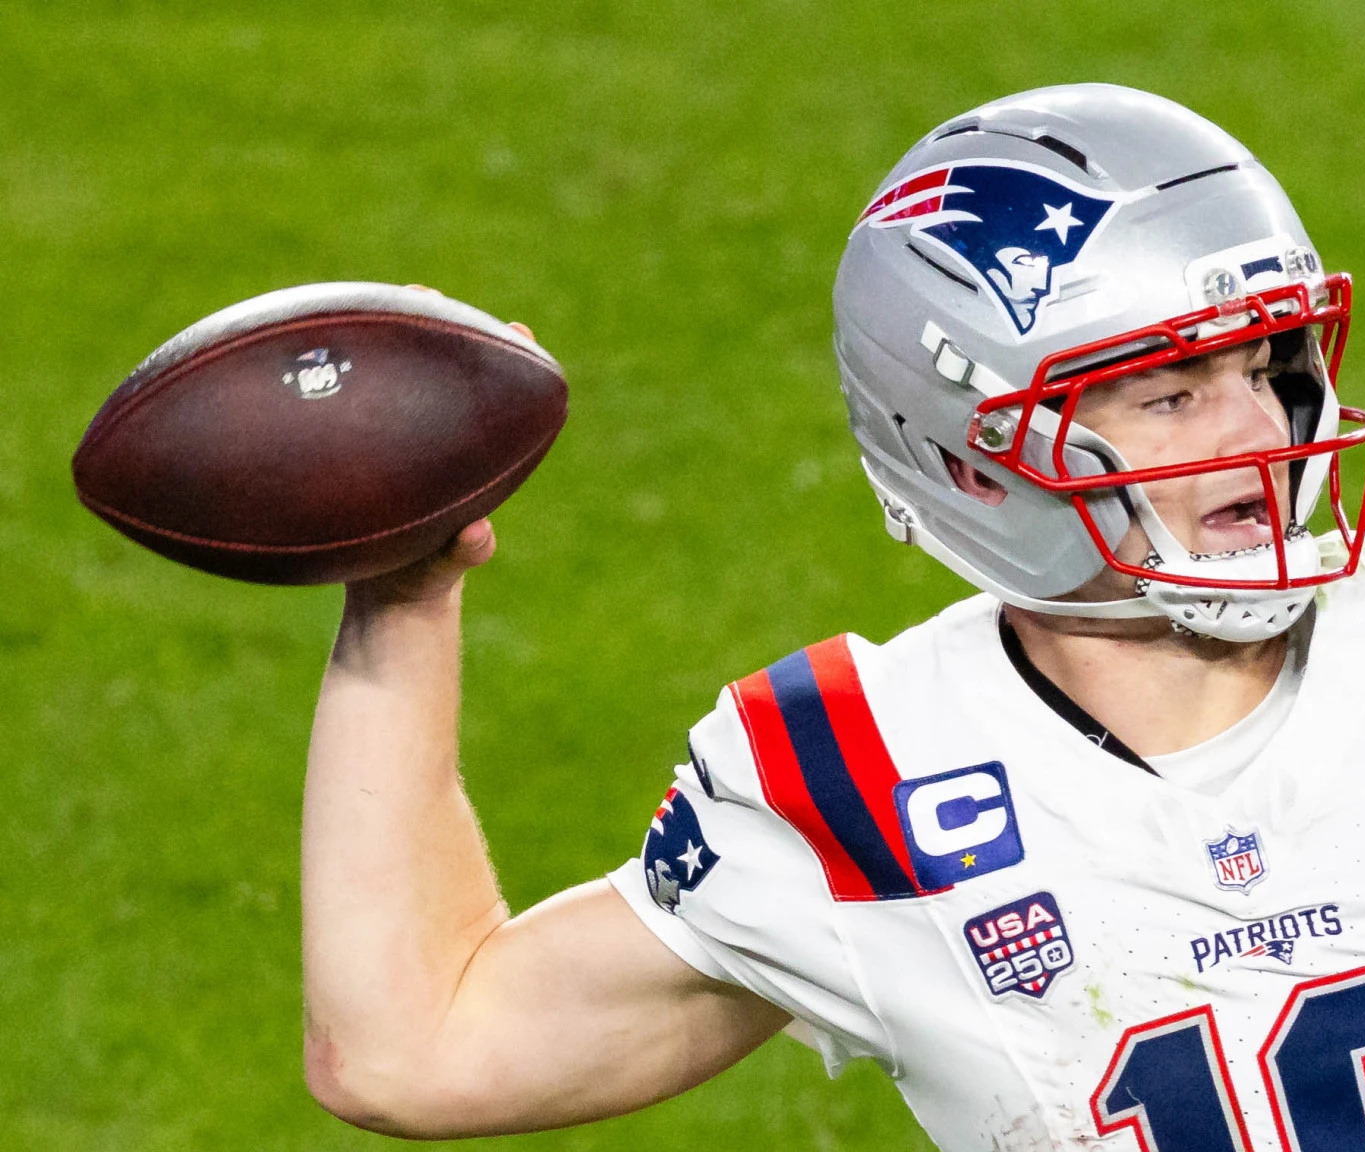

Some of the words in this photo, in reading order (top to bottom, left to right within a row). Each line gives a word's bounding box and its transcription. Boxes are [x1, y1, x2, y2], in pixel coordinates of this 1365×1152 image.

[906, 772, 1008, 857] C
[1218, 852, 1260, 881] NFL
[970, 902, 1056, 948] USA
[1190, 904, 1343, 974] PATRIOTS
[986, 939, 1072, 993] 250
